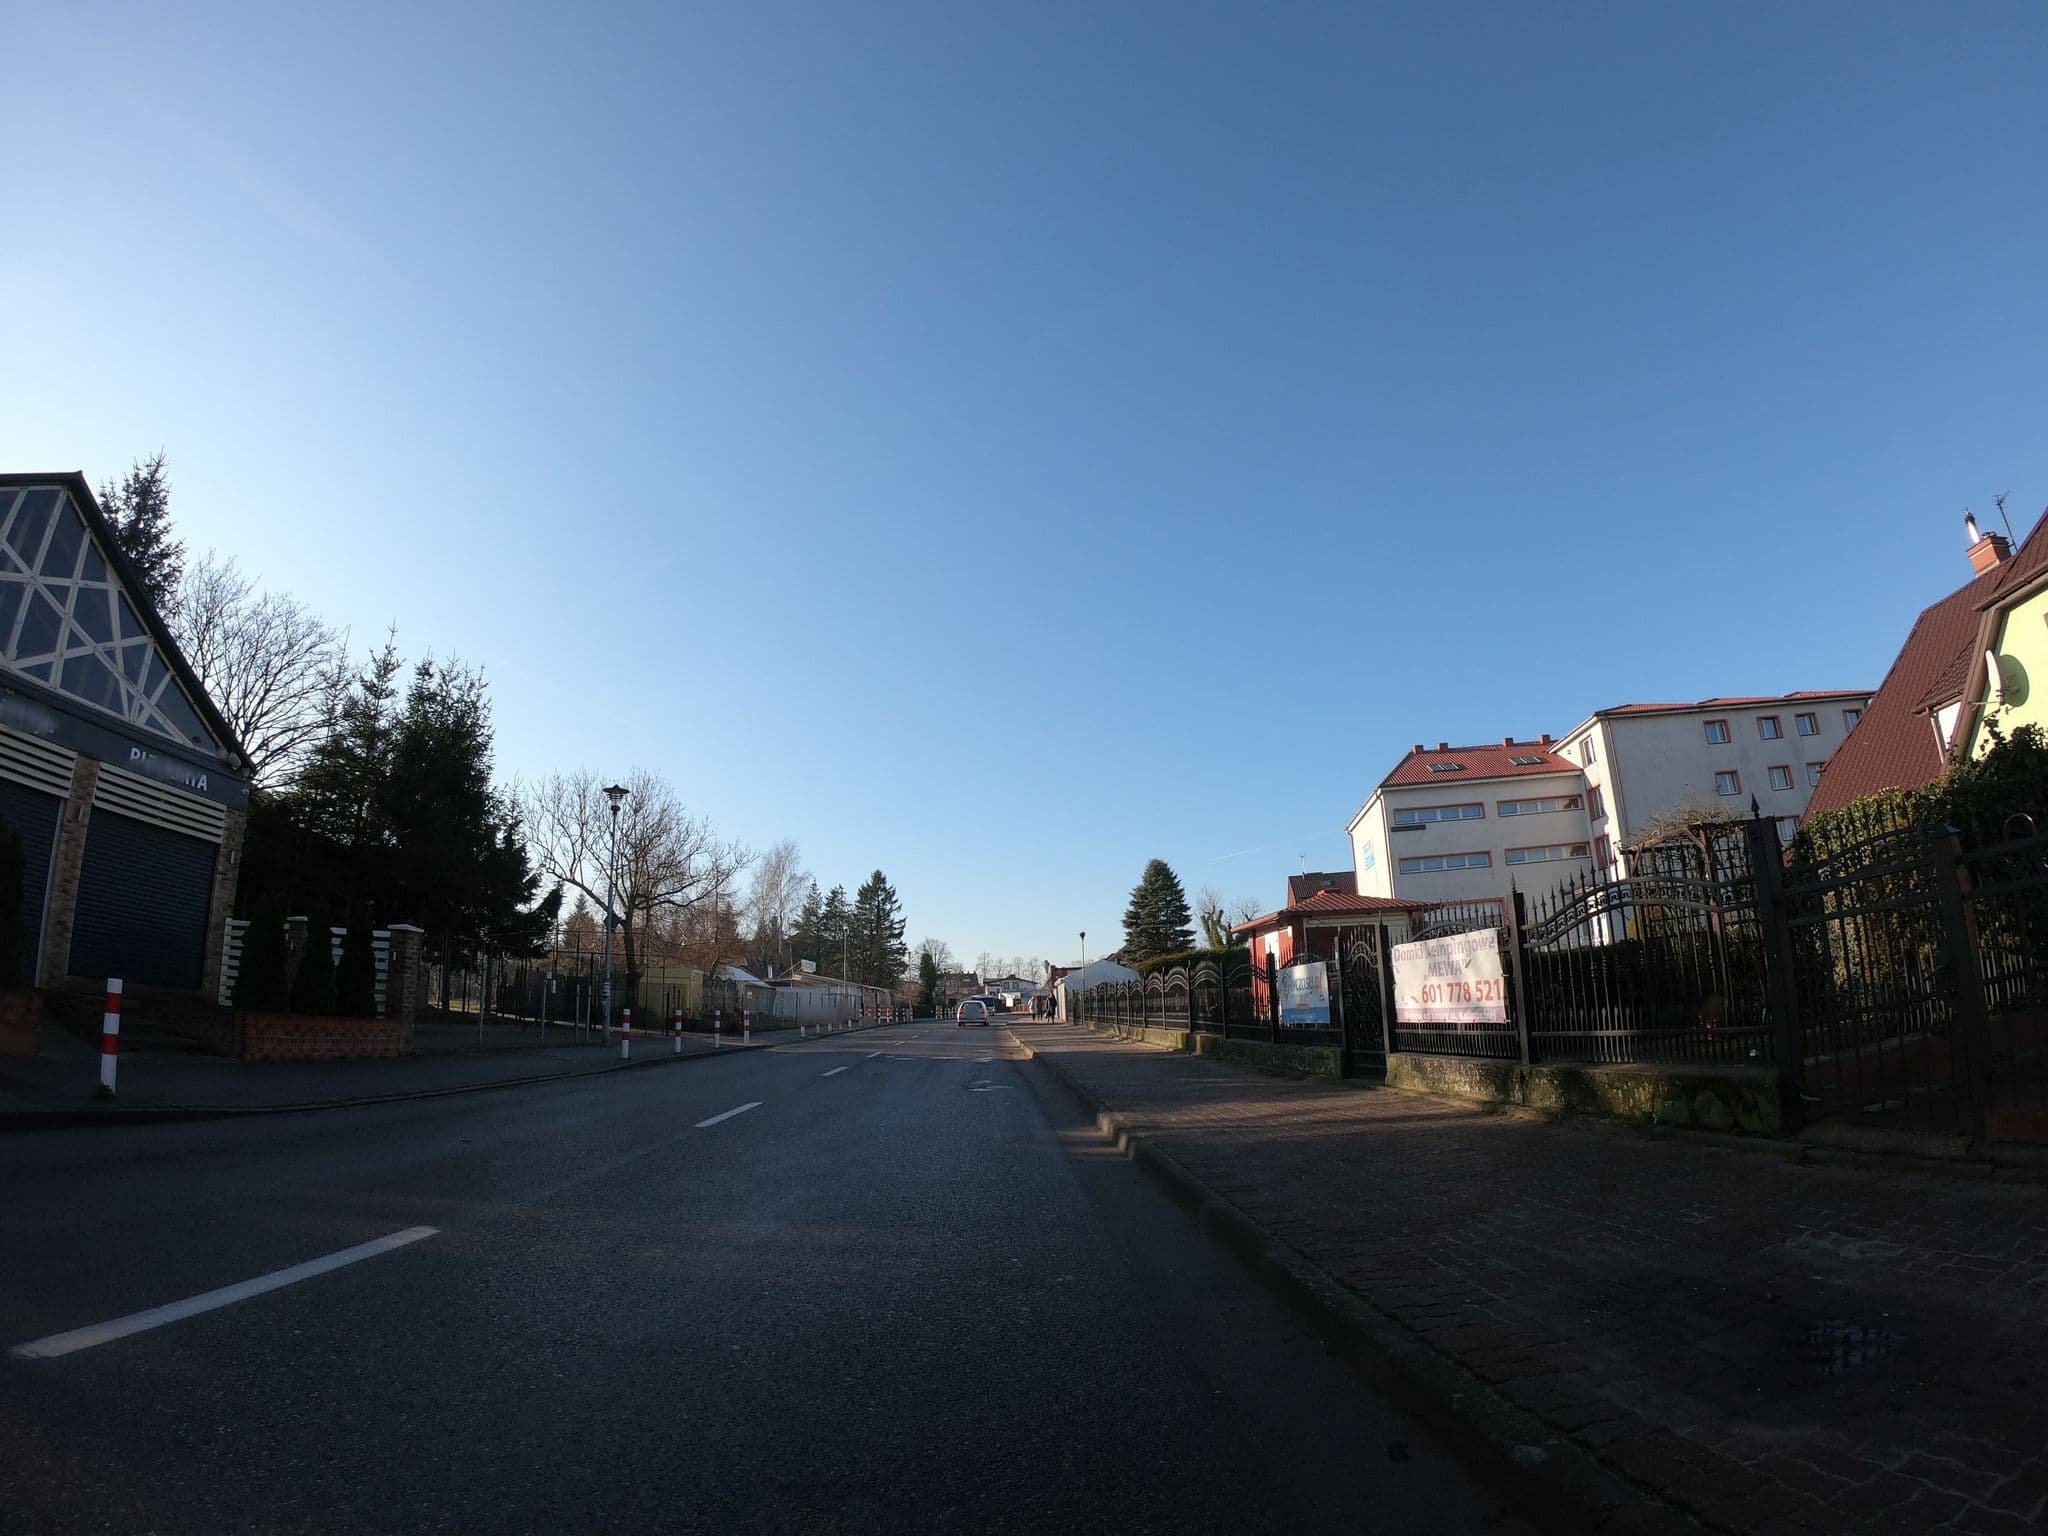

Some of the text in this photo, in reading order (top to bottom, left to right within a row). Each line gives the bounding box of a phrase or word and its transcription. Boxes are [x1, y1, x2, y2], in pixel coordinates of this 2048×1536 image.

[1394, 936, 1495, 961] Domki kempingowe
[1422, 979, 1501, 1003] 601 778 521
